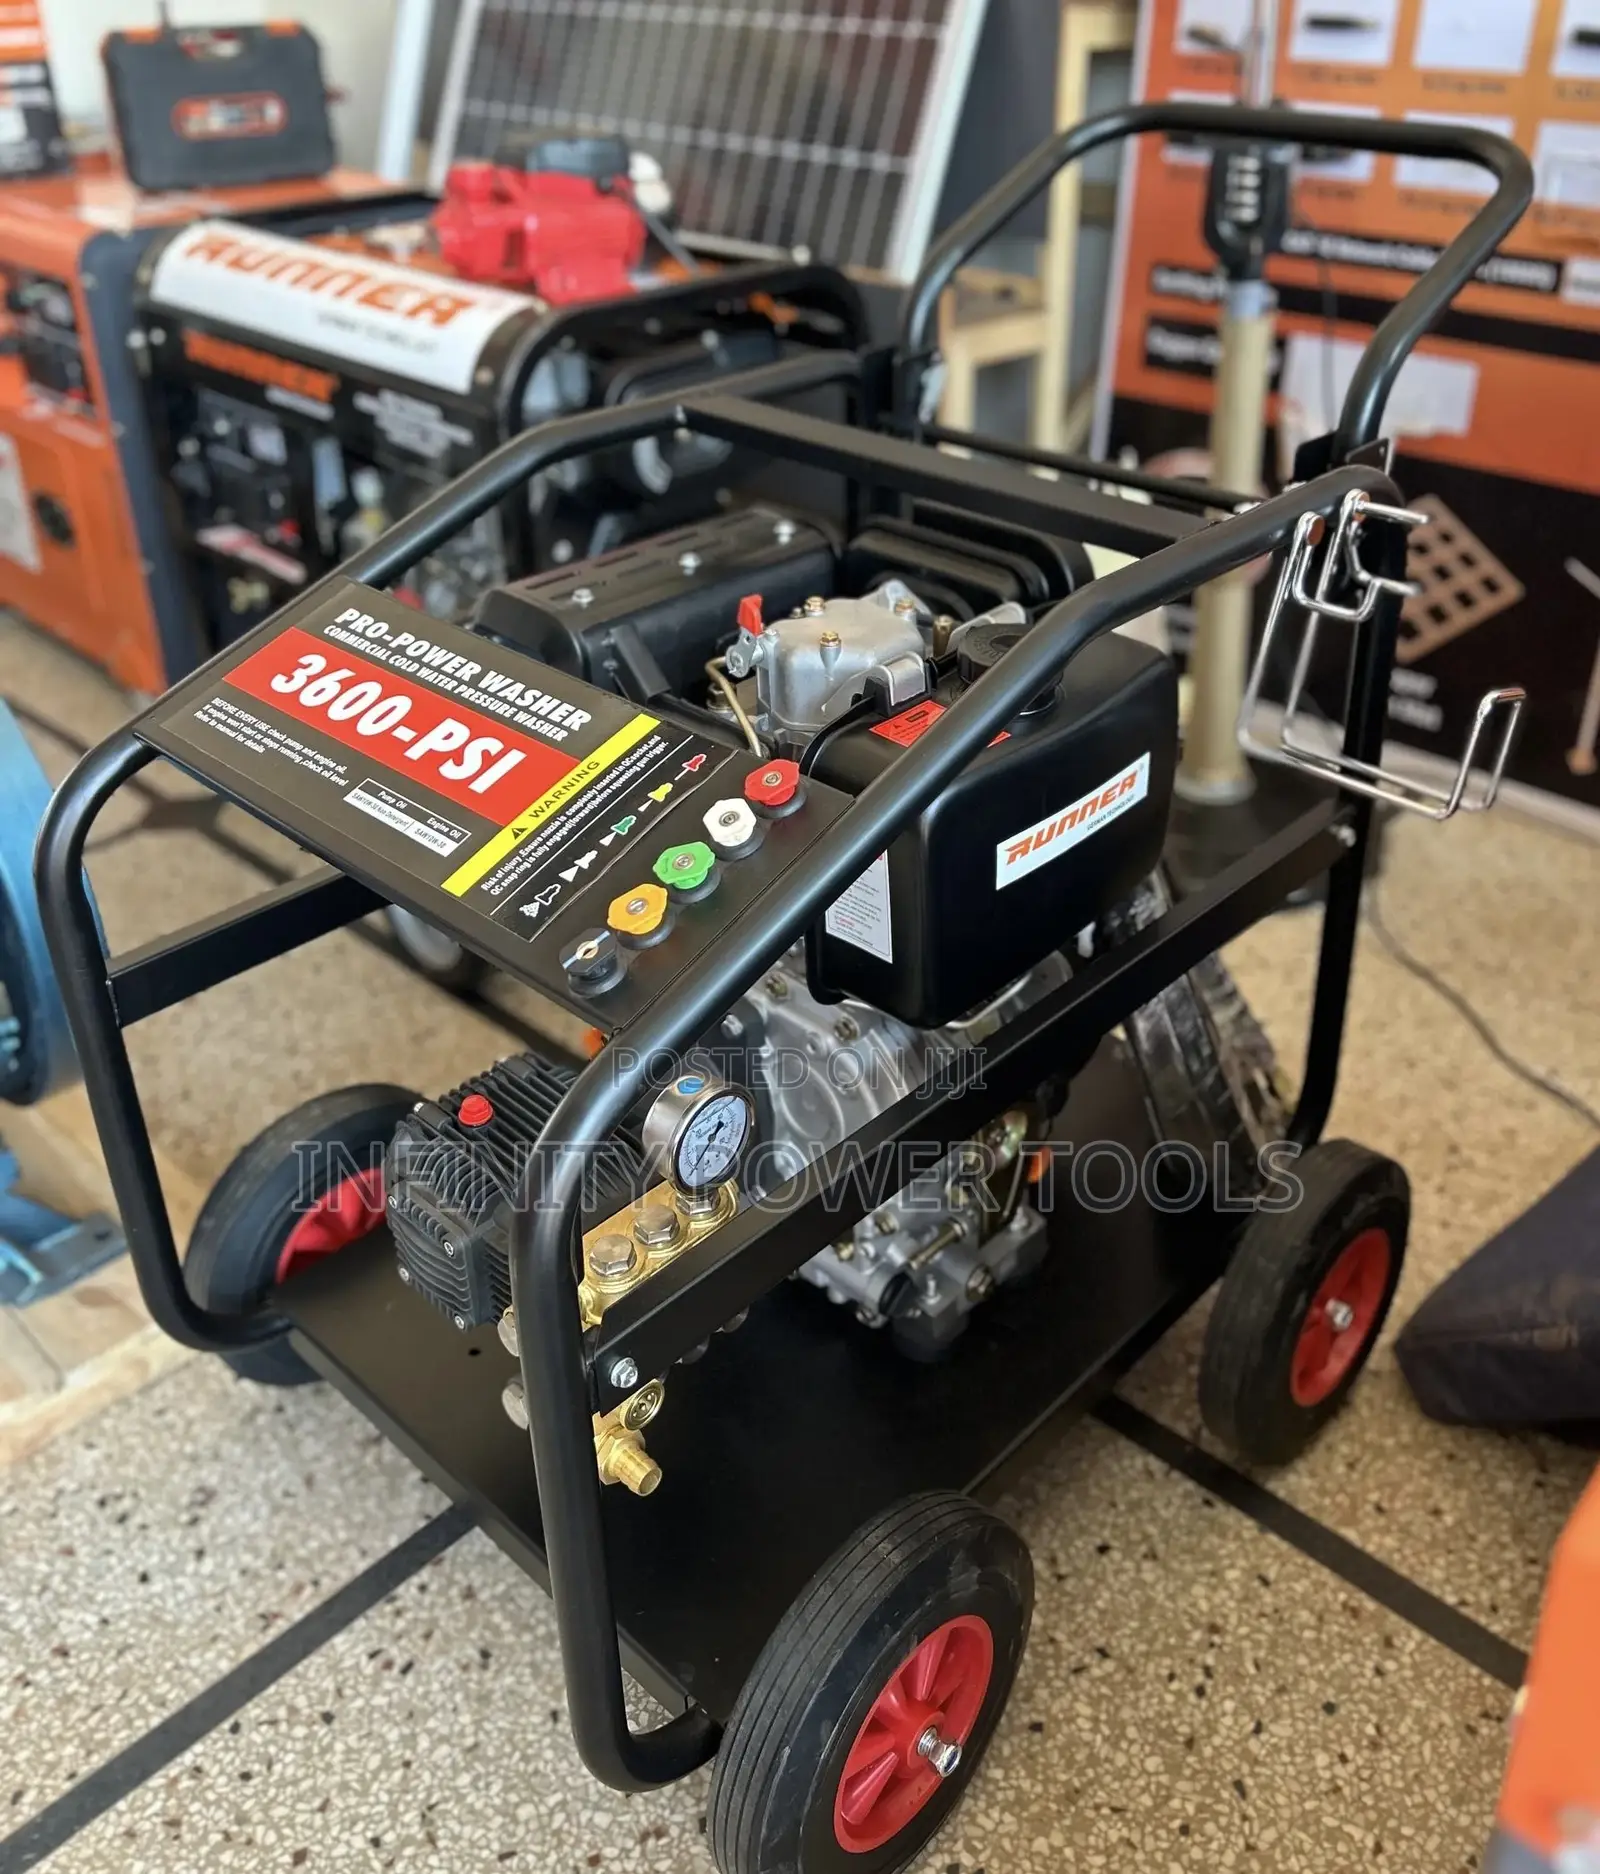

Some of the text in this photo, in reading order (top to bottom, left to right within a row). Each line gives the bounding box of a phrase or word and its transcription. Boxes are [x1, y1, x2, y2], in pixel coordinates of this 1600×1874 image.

[323, 625, 569, 743] COMMERCIAL COLD WATER PRESSURE WASHER
[334, 608, 592, 732] PRO-POWER WASHER
[194, 710, 211, 723] Refer
[208, 719, 218, 727] to
[215, 723, 239, 738] manual
[236, 733, 247, 742] for
[207, 708, 227, 721] engine
[226, 716, 245, 730] won't
[241, 725, 258, 737] start
[261, 736, 280, 749] stops
[321, 769, 334, 778] oil
[330, 773, 349, 787] level
[211, 697, 239, 715] BEFORE
[235, 708, 257, 724] EVERY
[254, 719, 271, 732] USE
[267, 728, 288, 741] check
[283, 738, 303, 751] pump
[301, 746, 318, 757] and
[314, 753, 337, 768] engine
[270, 654, 527, 794] 3600-PSI
[377, 791, 408, 810] Pump Oil
[427, 817, 462, 839] Engine Oil
[480, 876, 498, 891] Risk
[496, 870, 505, 878] of
[540, 820, 561, 838] nozzle
[565, 789, 598, 816] completely
[593, 769, 620, 790] inserted
[490, 885, 503, 895] QC
[501, 872, 518, 887] snap
[515, 861, 531, 874] ring
[532, 844, 549, 857] fully
[636, 757, 650, 768] gun
[529, 760, 600, 819] WARNING
[1004, 769, 1138, 866] RUNNER
